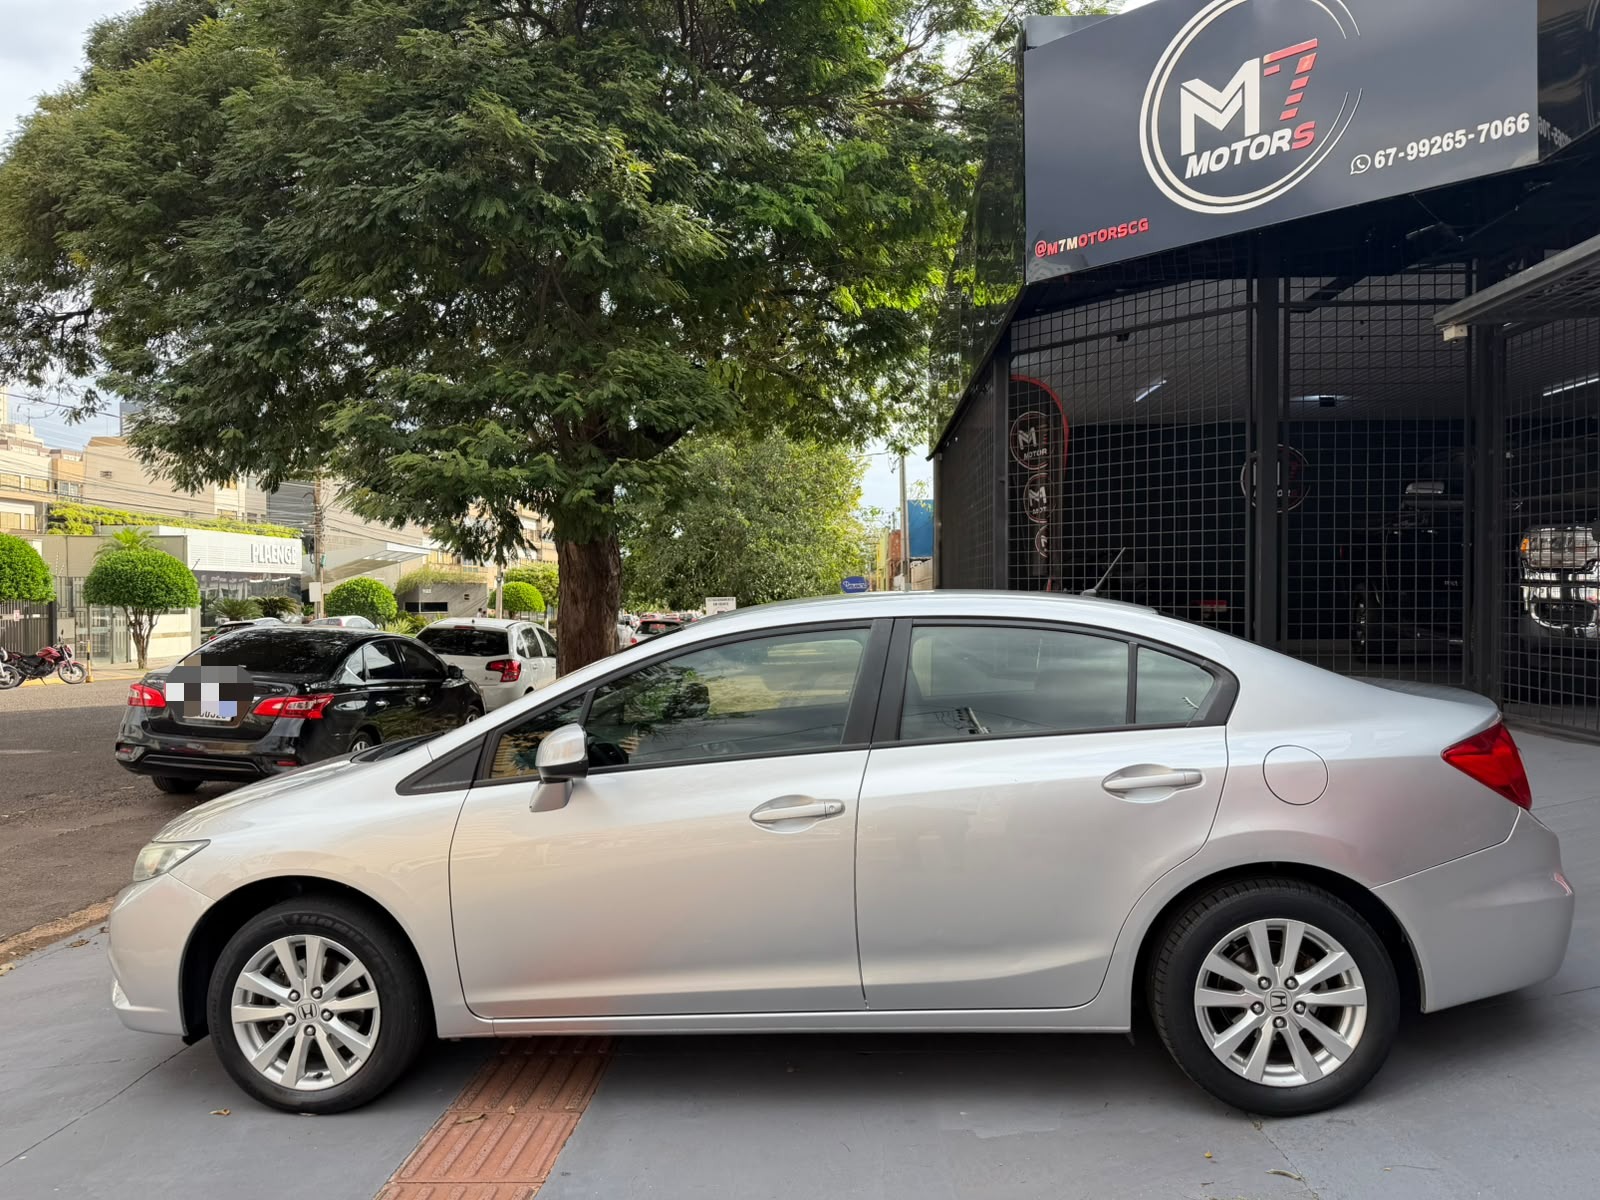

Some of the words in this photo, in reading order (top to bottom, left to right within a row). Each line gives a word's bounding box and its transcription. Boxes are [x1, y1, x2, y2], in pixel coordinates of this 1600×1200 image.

[1179, 38, 1318, 156] M7
[1185, 121, 1317, 179] MOTORS
[1373, 112, 1531, 169] 67-99265-7066
[1034, 217, 1150, 258] @M7MOTORSCG
[1023, 447, 1048, 461] MOTOR
[1032, 506, 1047, 515] MOT
[250, 543, 297, 565] PLAENGE
